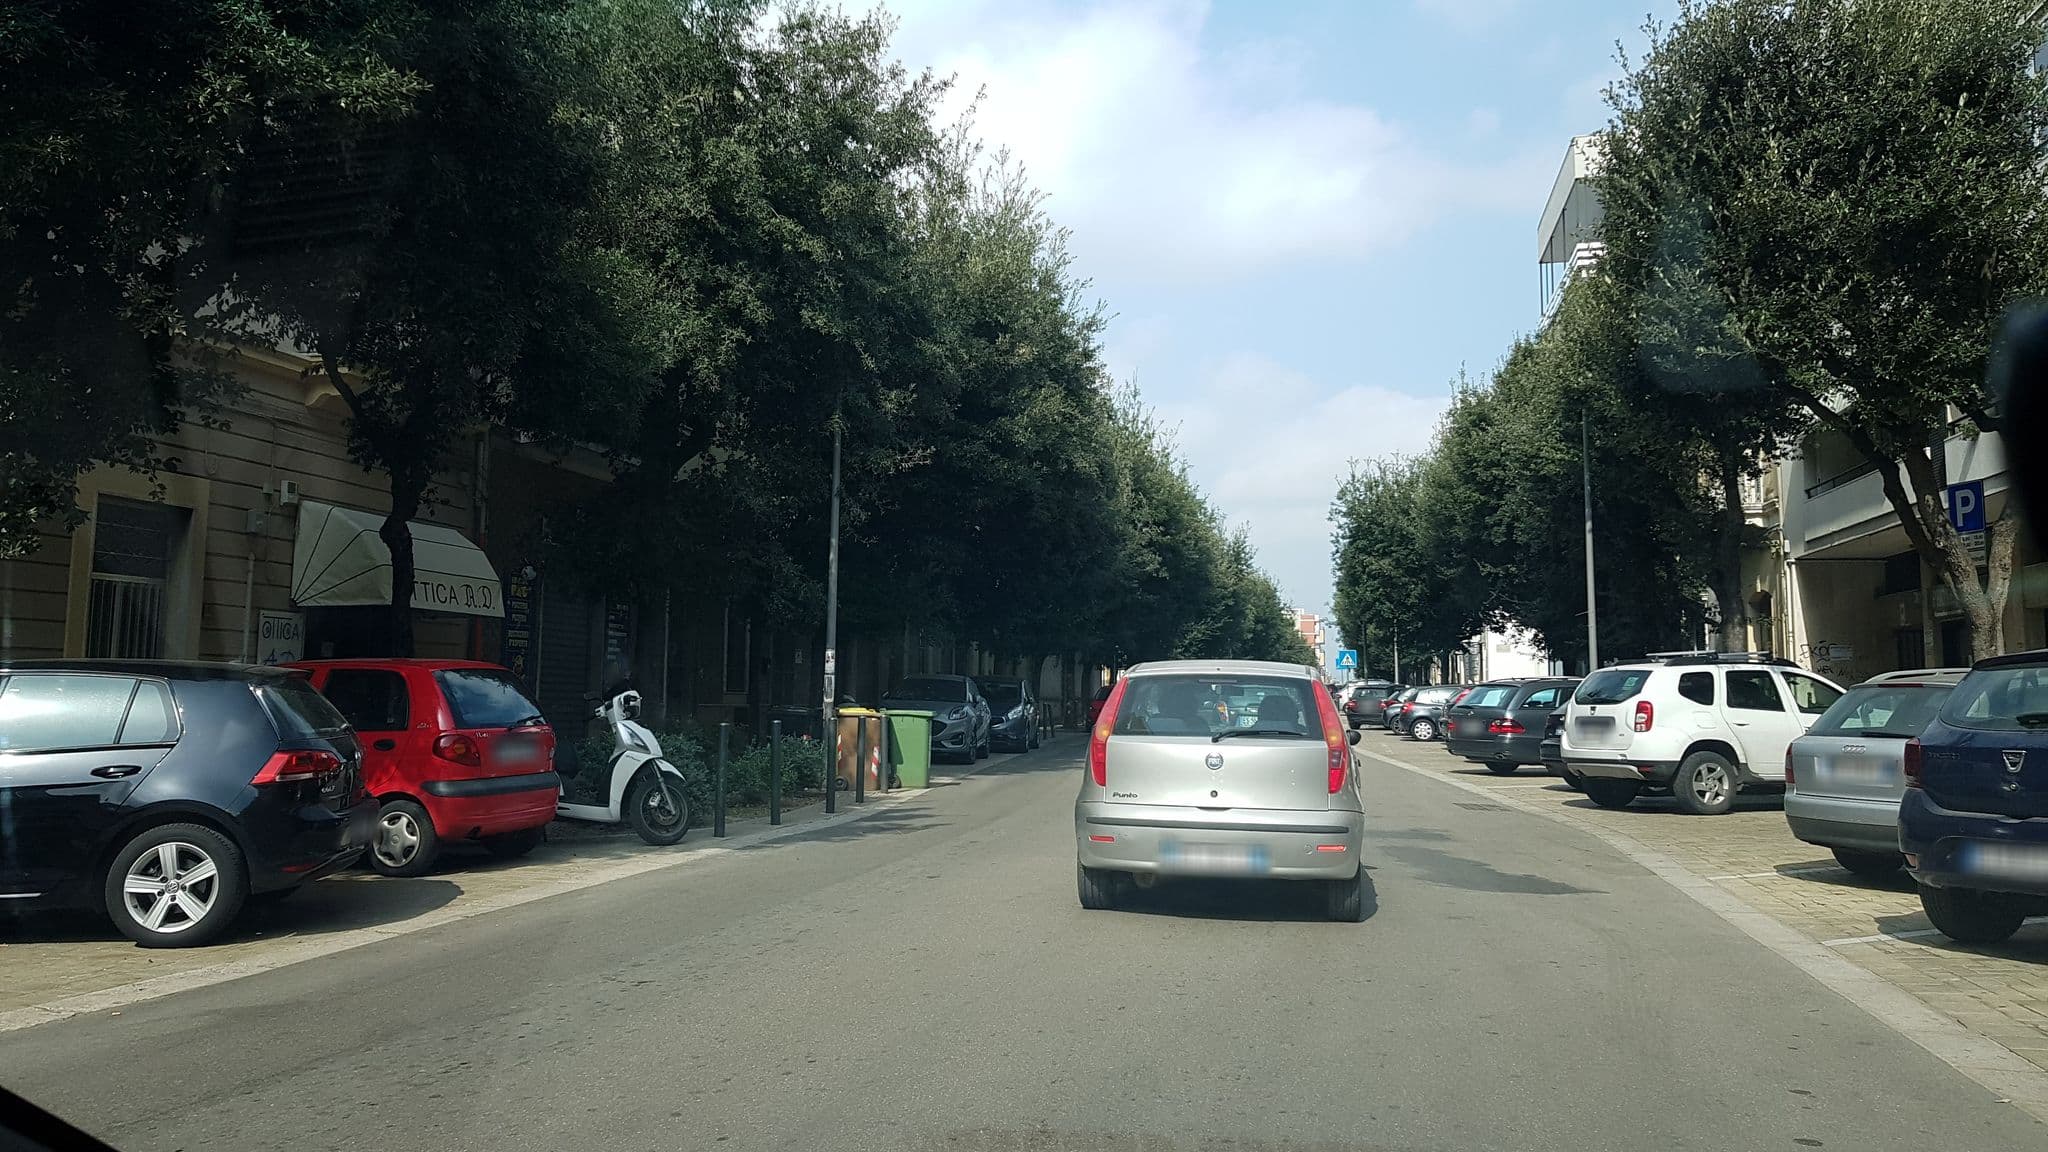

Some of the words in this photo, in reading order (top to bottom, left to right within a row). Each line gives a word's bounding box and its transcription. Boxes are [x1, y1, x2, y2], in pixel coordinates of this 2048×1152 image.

[1955, 489, 1976, 527] P
[411, 581, 459, 605] TTICA
[1112, 790, 1138, 799] Punto
